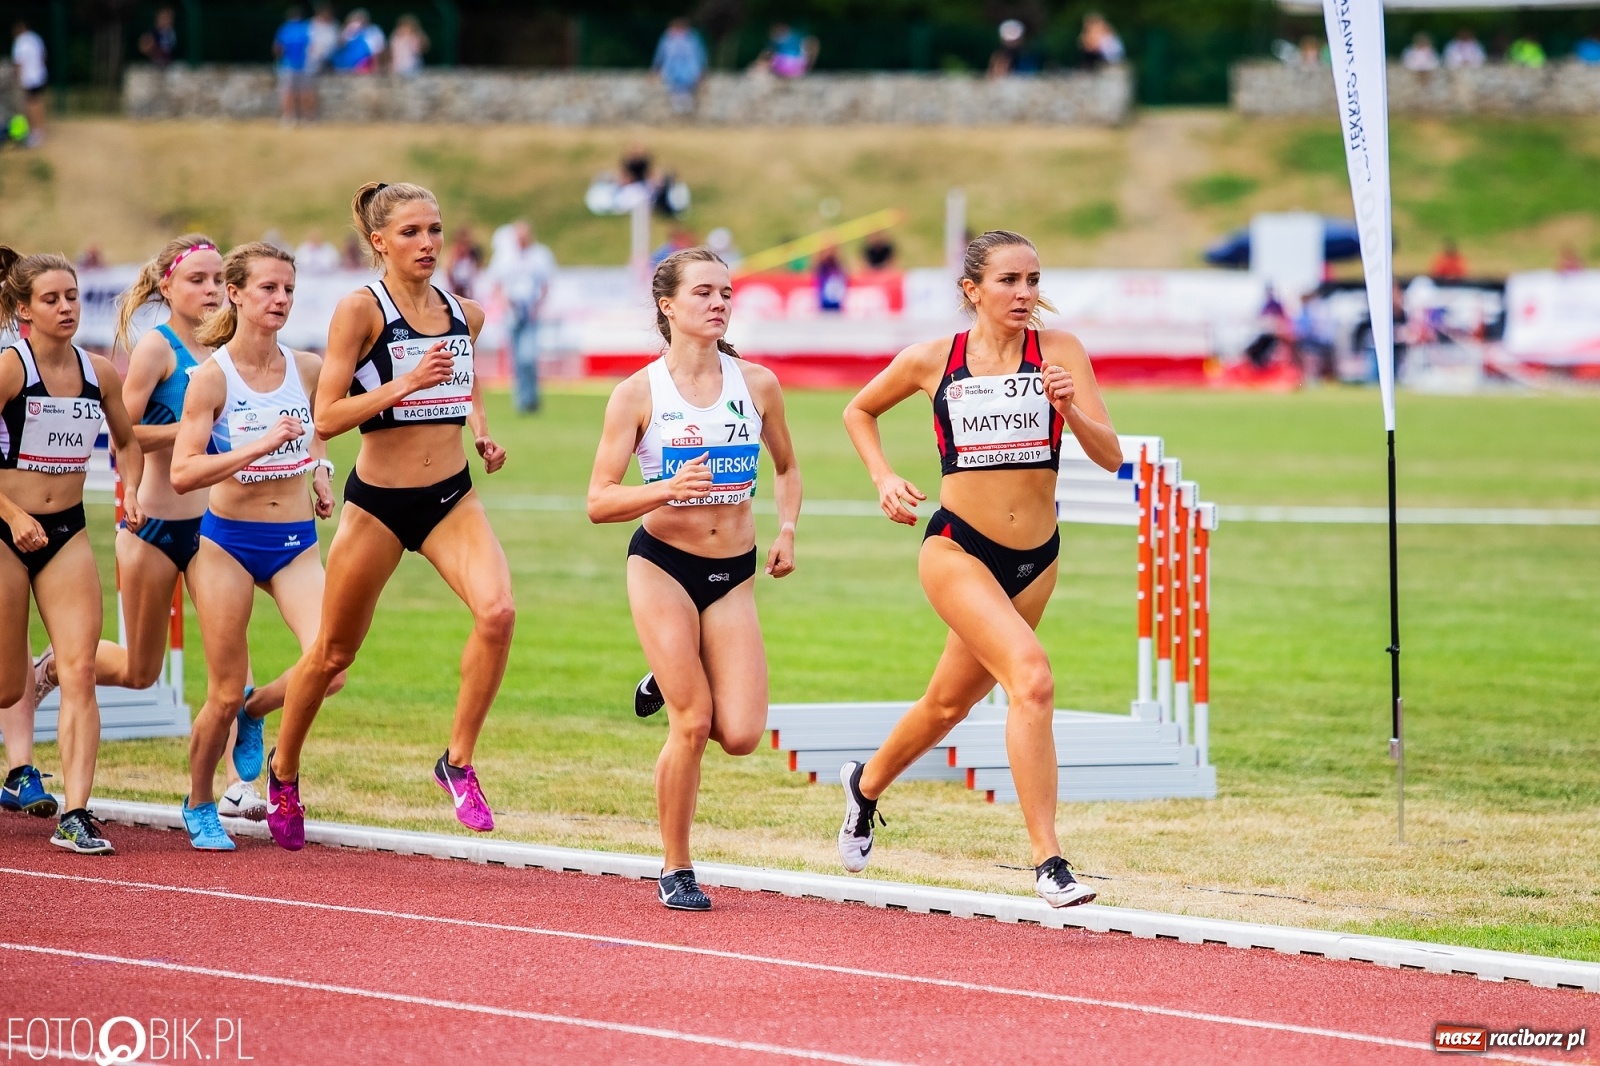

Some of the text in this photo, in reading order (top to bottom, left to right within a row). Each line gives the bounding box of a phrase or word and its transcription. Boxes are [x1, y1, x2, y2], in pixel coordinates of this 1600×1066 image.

[1004, 377, 1044, 398] 370
[404, 405, 466, 418] RACIBÓRZ 2019
[661, 412, 684, 421] esa
[962, 412, 1040, 432] MATYSIK
[48, 432, 83, 447] PYKA
[724, 423, 750, 443] 74
[964, 450, 1041, 465] RACIBÓRZ 2019
[708, 572, 729, 582] esa
